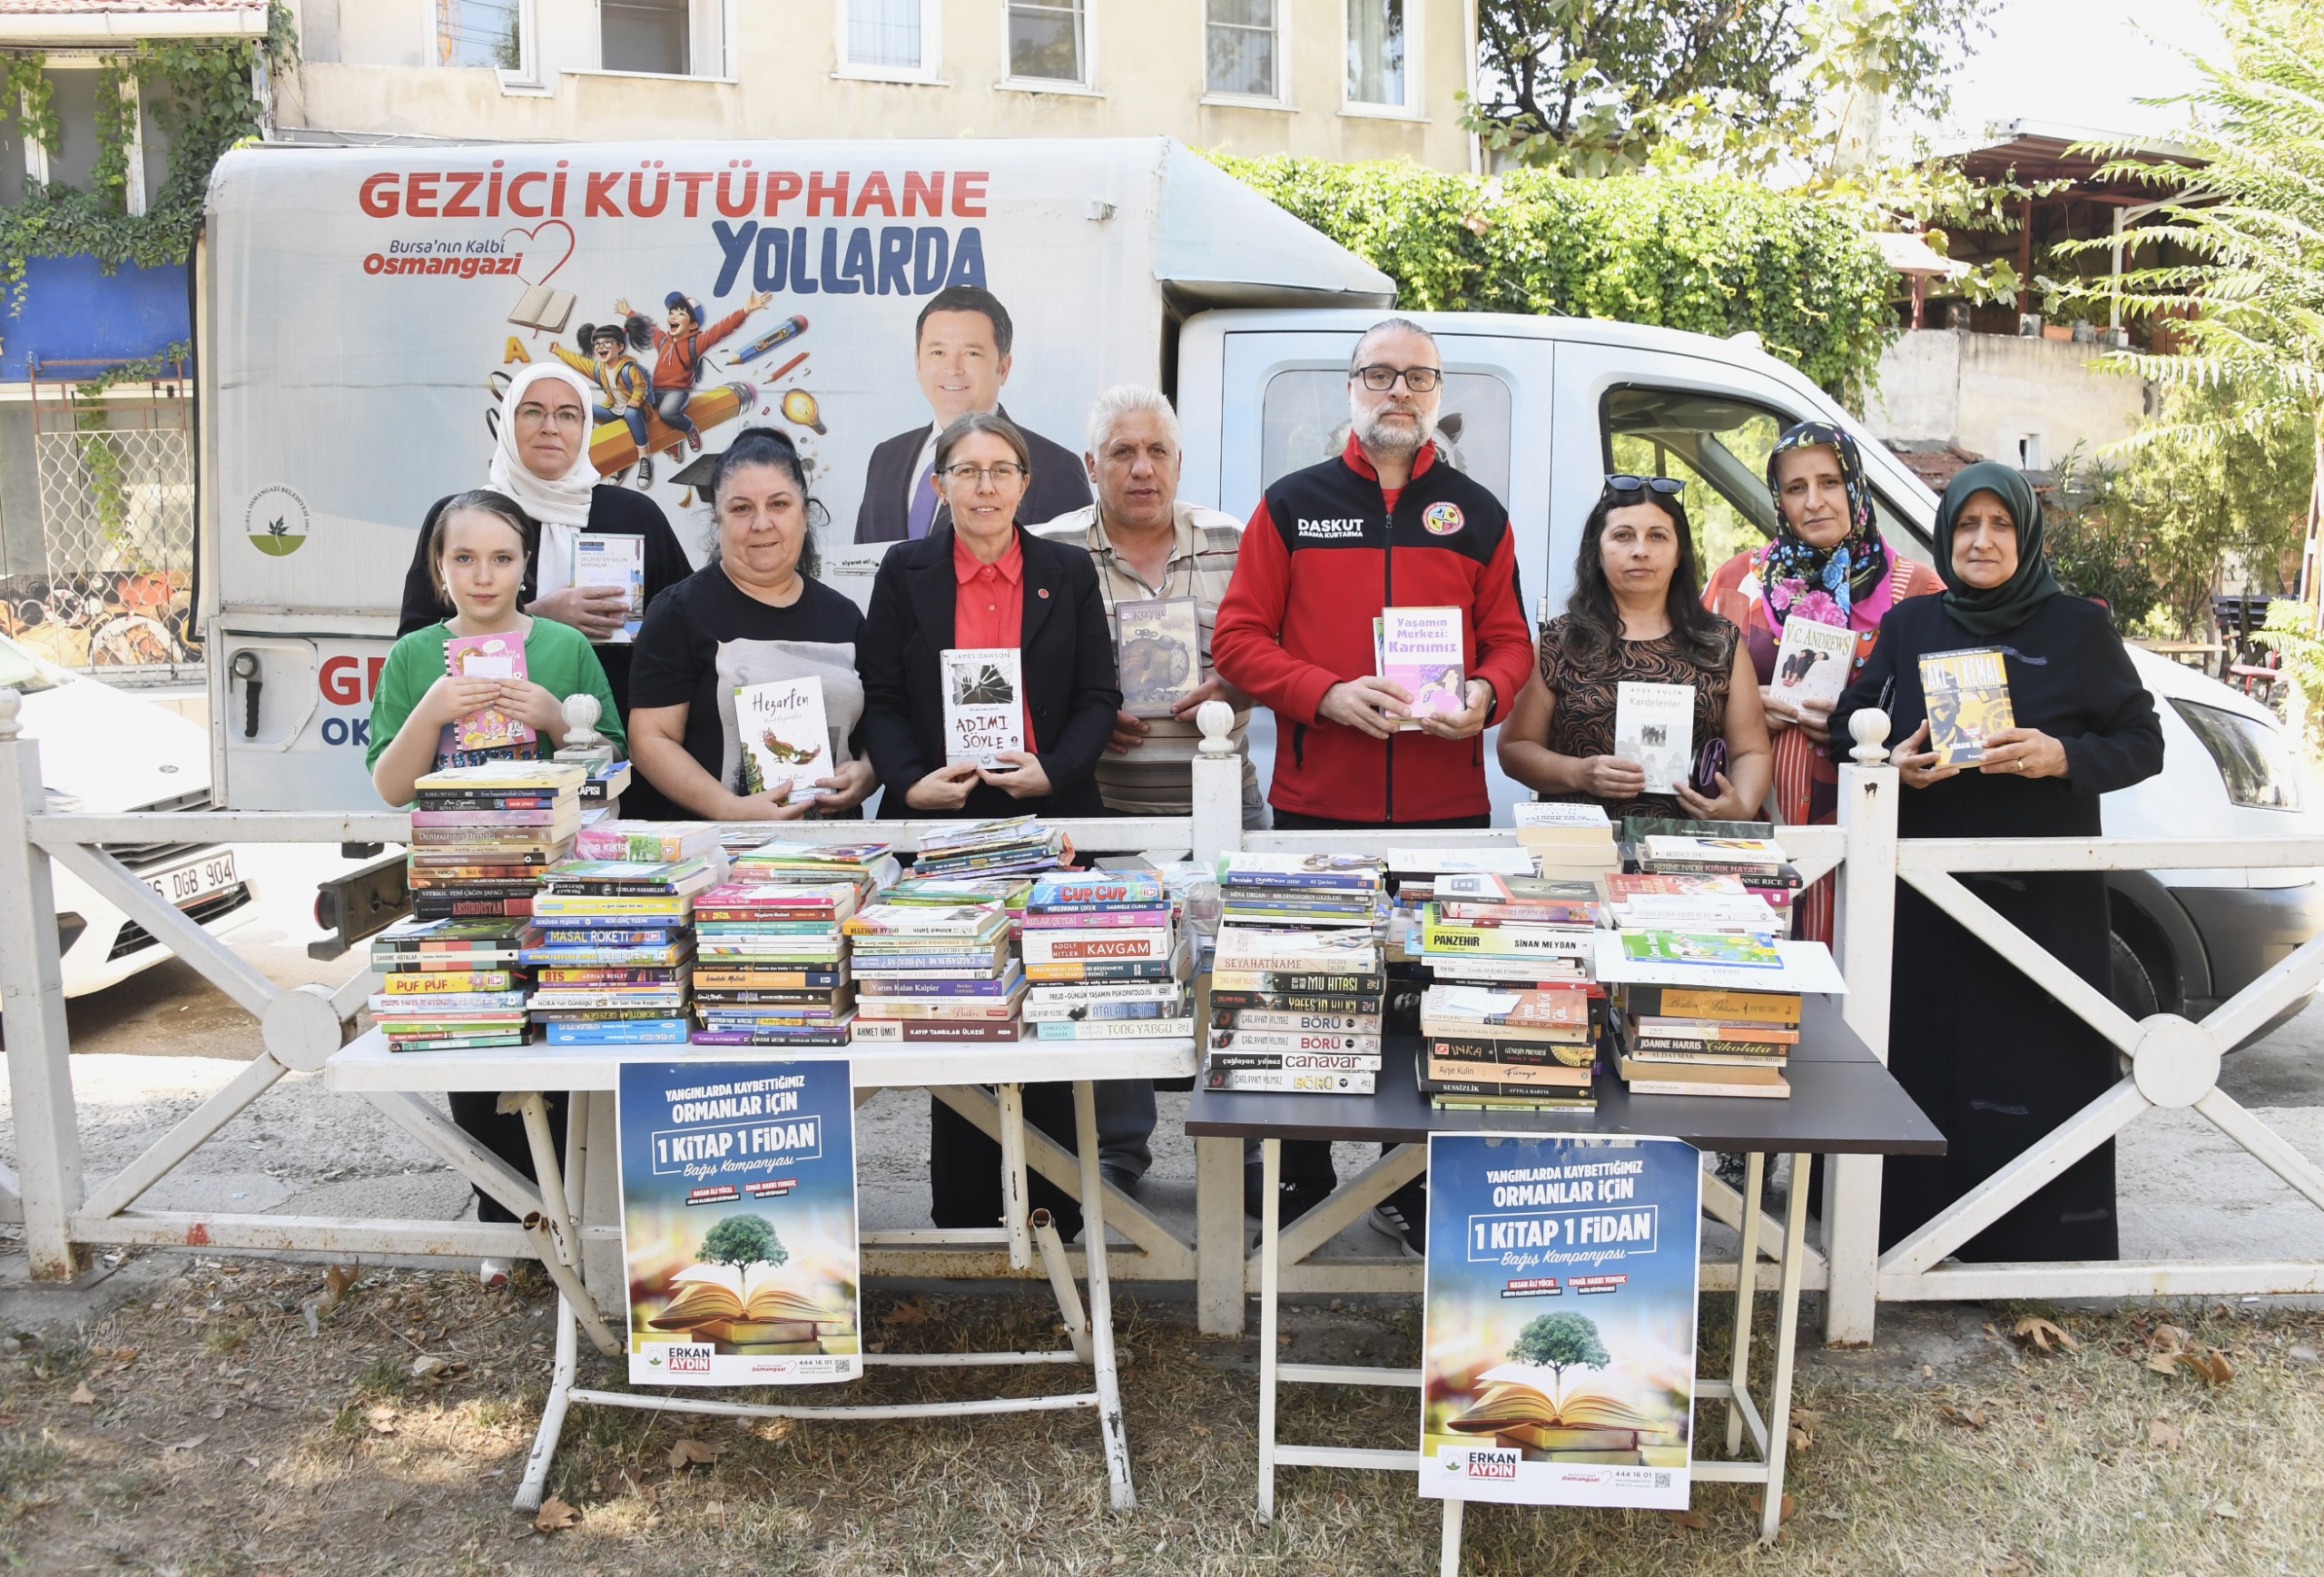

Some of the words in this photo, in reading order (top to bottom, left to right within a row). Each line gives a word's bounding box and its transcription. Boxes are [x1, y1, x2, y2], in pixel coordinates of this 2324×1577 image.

[359, 159, 569, 219] GEZİCİ
[585, 159, 990, 218] KÜTÜPHANE
[466, 239, 506, 253] Kalbi
[712, 220, 988, 298] YOLLARDA
[362, 252, 524, 280] Osmangazi
[1297, 518, 1364, 531] DASKUT
[1298, 530, 1324, 538] ARAMA
[1324, 530, 1364, 538] KURTARMA
[1396, 617, 1447, 630] Yaşamın
[1396, 629, 1448, 639] Merkezi:
[1388, 641, 1457, 654] Karnımız
[1804, 627, 1852, 655] ANDREWS
[954, 652, 976, 661] JAMES
[978, 652, 1010, 660] DAWSON
[1961, 655, 2002, 685] KEMAL
[752, 687, 809, 717] Hezarfen
[1630, 697, 1681, 709] Kardelenler
[956, 715, 1009, 734] ADIMI
[963, 733, 1004, 750] SÖYLE
[1705, 864, 1728, 872] KIRIK
[1730, 865, 1758, 873] HAYAT
[172, 868, 199, 899] DGB
[205, 858, 232, 887] 904
[1060, 886, 1093, 902] CUP
[1095, 885, 1128, 902] CUP
[1282, 892, 1315, 901] DİNOZORUN
[536, 917, 558, 925] SERÜVEN
[559, 917, 580, 926] PEŞİNDE
[550, 931, 587, 942] MASAL
[590, 930, 629, 942] ROKETİ
[1433, 934, 1481, 946] PANZEHİR
[1514, 938, 1540, 948] SİNAN
[1541, 941, 1576, 950] MEYDAN
[1087, 942, 1149, 955] KAVGAM
[1225, 959, 1302, 969] SEYAHATNAME
[545, 971, 565, 981] BTS
[397, 980, 419, 991] PUF
[425, 979, 448, 991] PUF
[872, 983, 892, 991] Yarım
[894, 983, 913, 991] Kalan
[914, 983, 940, 993] Kalpler
[1307, 976, 1324, 991] MU
[1327, 976, 1358, 991] KITASI
[1049, 992, 1064, 1000] FREUD
[583, 1011, 617, 1020] GEZEGENİ
[619, 1010, 655, 1019] ROBOTLAR
[1107, 1024, 1134, 1034] TONG
[1137, 1023, 1172, 1034] YABGU
[1241, 1014, 1268, 1024] ÇAĞLAYAN
[1269, 1015, 1289, 1024] YILMAZ
[1301, 1015, 1341, 1030] BÖRÜ
[857, 1027, 878, 1037] AHMET
[880, 1025, 897, 1037] ÜMİT
[1241, 1036, 1268, 1046] ÇAĞLAYAN
[1269, 1037, 1289, 1045] YILMAZ
[1300, 1035, 1341, 1050] BÖRÜ
[1640, 1037, 1672, 1049] JOANNE
[1673, 1039, 1702, 1050] HARRIS
[1285, 1055, 1361, 1069] canavar
[1439, 1067, 1454, 1077] Ayşe
[1457, 1067, 1474, 1075] Kulin
[665, 1084, 733, 1102] YANGINLARDA
[734, 1075, 805, 1095] KAYBETTİĞİMİZ
[1236, 1075, 1262, 1086] ÇAĞLAYAN
[1263, 1076, 1283, 1085] YILMAZ
[1294, 1075, 1334, 1089] BÖRÜ
[1443, 1084, 1480, 1092] SESSİZLİK
[672, 1096, 763, 1124] ORMANLAR
[765, 1091, 798, 1115] İÇİN
[657, 1138, 667, 1163] 1
[673, 1132, 733, 1162] KİTAP
[737, 1130, 747, 1155] 1
[752, 1122, 815, 1154] FİDAN
[683, 1163, 718, 1181] Bağış
[721, 1156, 795, 1175] Kampanyası
[1486, 1169, 1561, 1184] YANGINLARDA
[1563, 1160, 1643, 1179] KAYBETTİĞİMİZ
[1492, 1183, 1593, 1207] ORMANLAR
[1598, 1178, 1634, 1203] İÇİN
[1474, 1224, 1484, 1249] 1
[1491, 1219, 1559, 1249] KİTAP
[1564, 1217, 1574, 1244] 1
[1580, 1213, 1650, 1244] FİDAN
[1501, 1251, 1540, 1271] Bağış
[1542, 1248, 1626, 1267] Kampanyası
[1509, 1281, 1528, 1289] HASAN
[1538, 1278, 1555, 1287] YÜCEL
[1569, 1277, 1587, 1286] İSMAİL
[1587, 1276, 1604, 1285] HAKKI
[668, 1347, 710, 1358] ERKAN
[670, 1358, 709, 1370] AYDIN
[1469, 1452, 1516, 1464] ERKAN
[1469, 1464, 1514, 1477] AYDIN
[1561, 1475, 1600, 1483] Osmangazi
